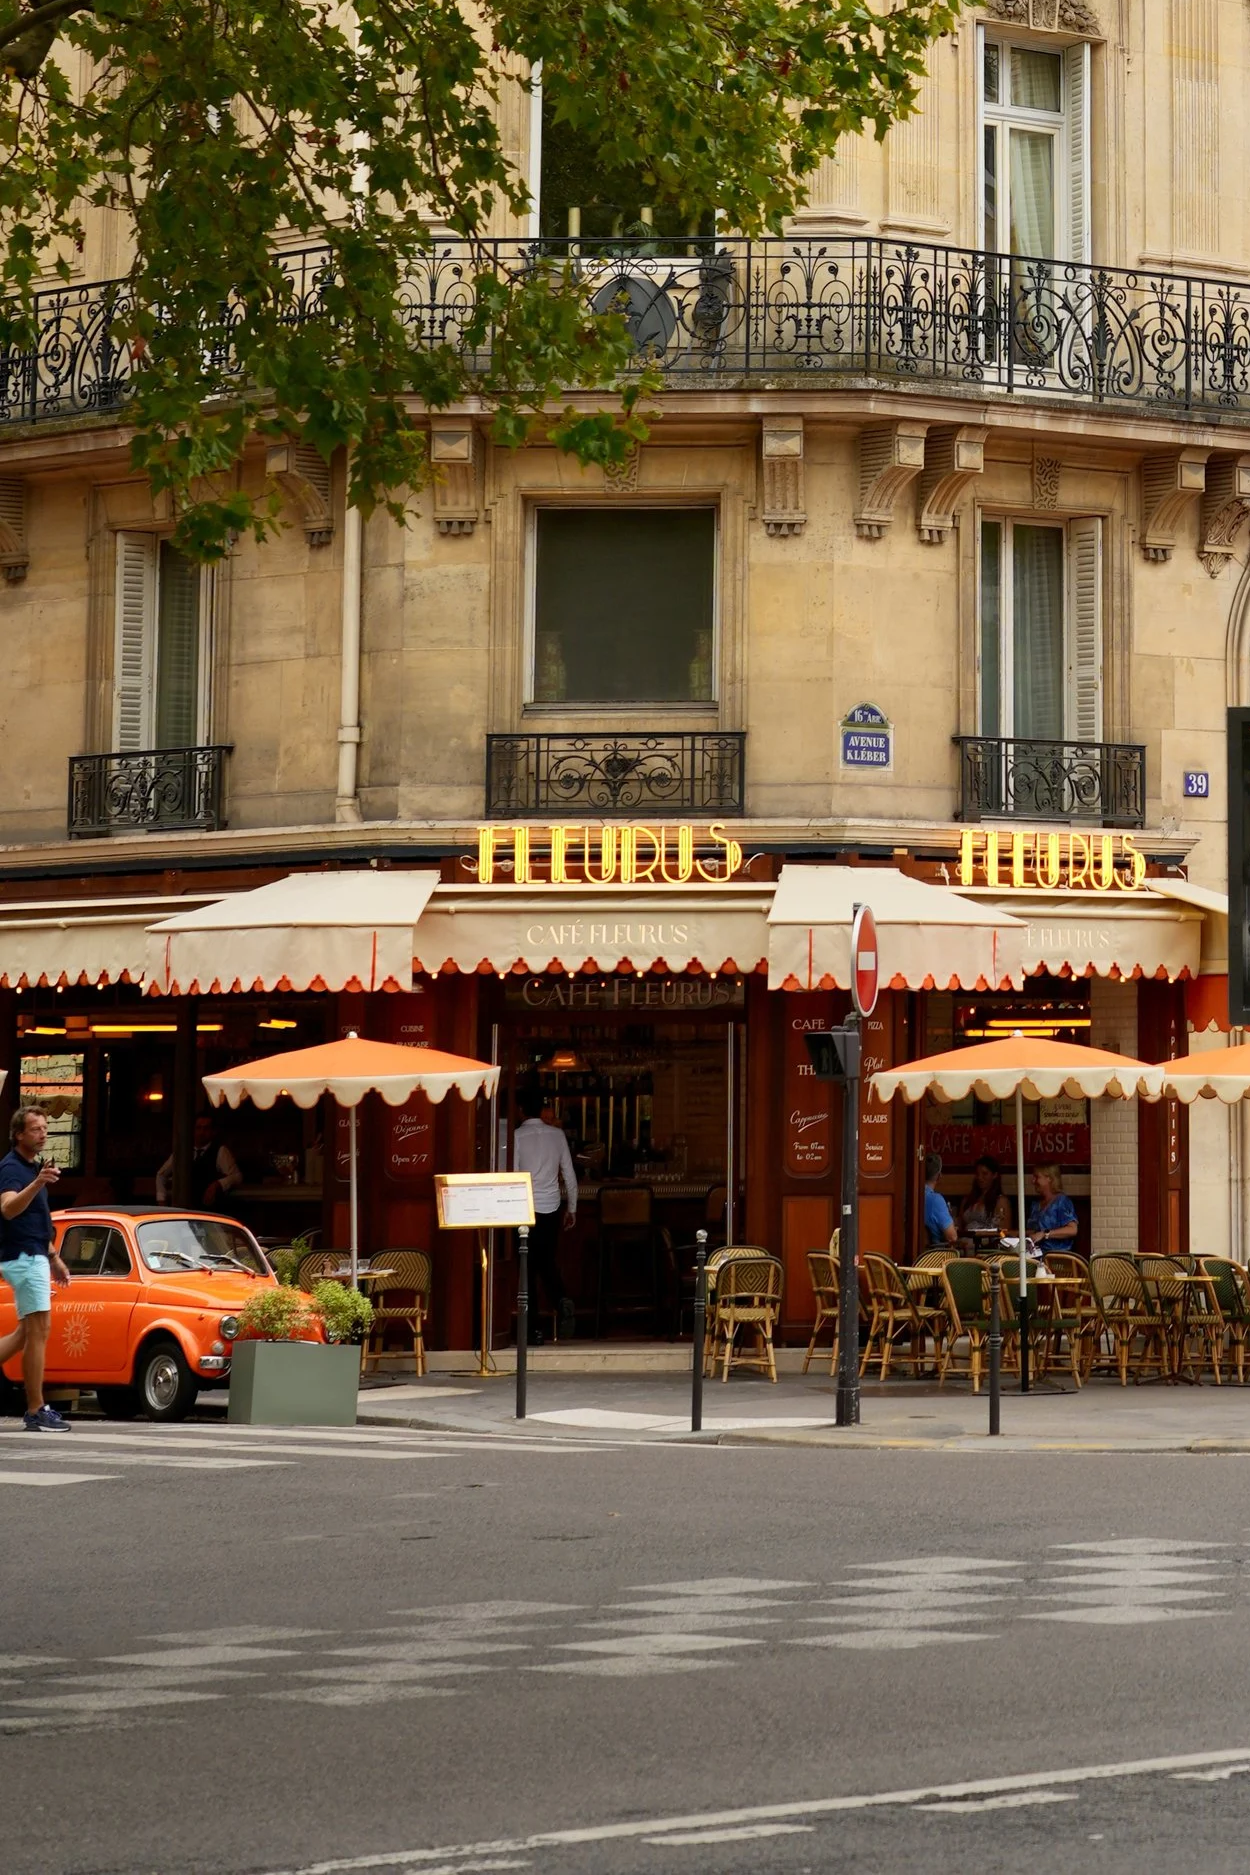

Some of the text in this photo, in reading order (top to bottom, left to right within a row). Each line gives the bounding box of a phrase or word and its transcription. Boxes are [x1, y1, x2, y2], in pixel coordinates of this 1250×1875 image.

[849, 736, 886, 748] AVENUE
[846, 748, 887, 762] KLÉBER
[1188, 774, 1207, 794] 39
[476, 823, 742, 884] FLEURUS
[960, 828, 1146, 890] FLEURUS
[527, 919, 688, 945] CAFÉ FLEURUS
[1040, 927, 1110, 949] FLEURUS
[613, 979, 731, 1005] FLEURUS
[868, 1022, 883, 1030] PIZZA
[798, 1065, 816, 1075] TH
[864, 1057, 884, 1072] Plat
[399, 1114, 417, 1124] Petit
[863, 1114, 888, 1124] SALADES
[1025, 1129, 1075, 1153] TASSE
[392, 1154, 428, 1165] Open 7/7
